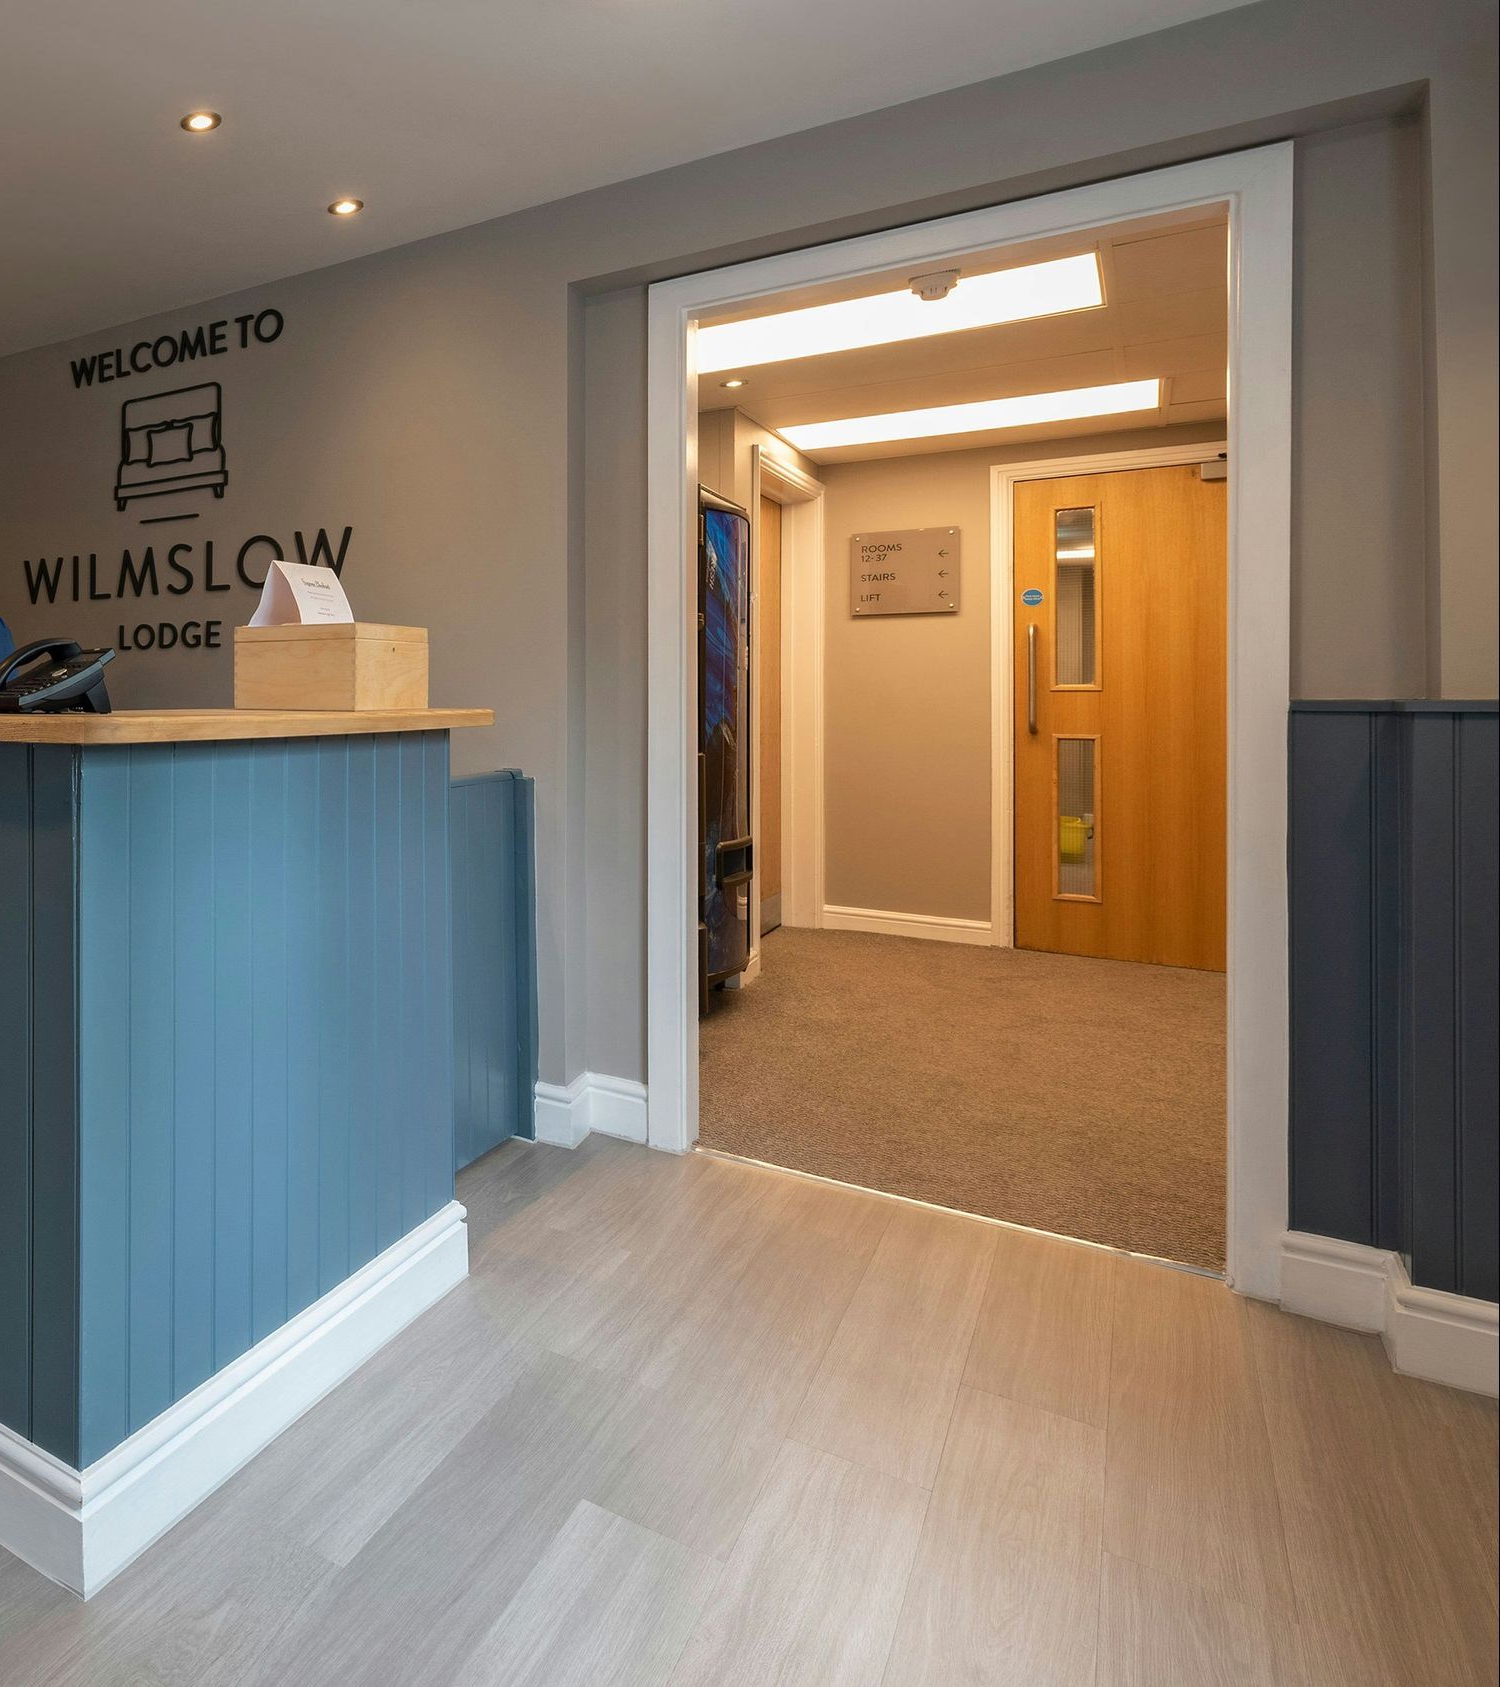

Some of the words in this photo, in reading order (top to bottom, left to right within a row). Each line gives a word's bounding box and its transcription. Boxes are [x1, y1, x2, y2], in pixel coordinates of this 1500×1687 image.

[70, 320, 228, 389] WELCOME
[234, 308, 284, 349] TO
[861, 543, 902, 554] ROOMS
[23, 526, 353, 605] WILMSLOW
[860, 572, 896, 583] STAIRS
[860, 593, 881, 603] LIFT
[118, 620, 222, 651] LODGE
